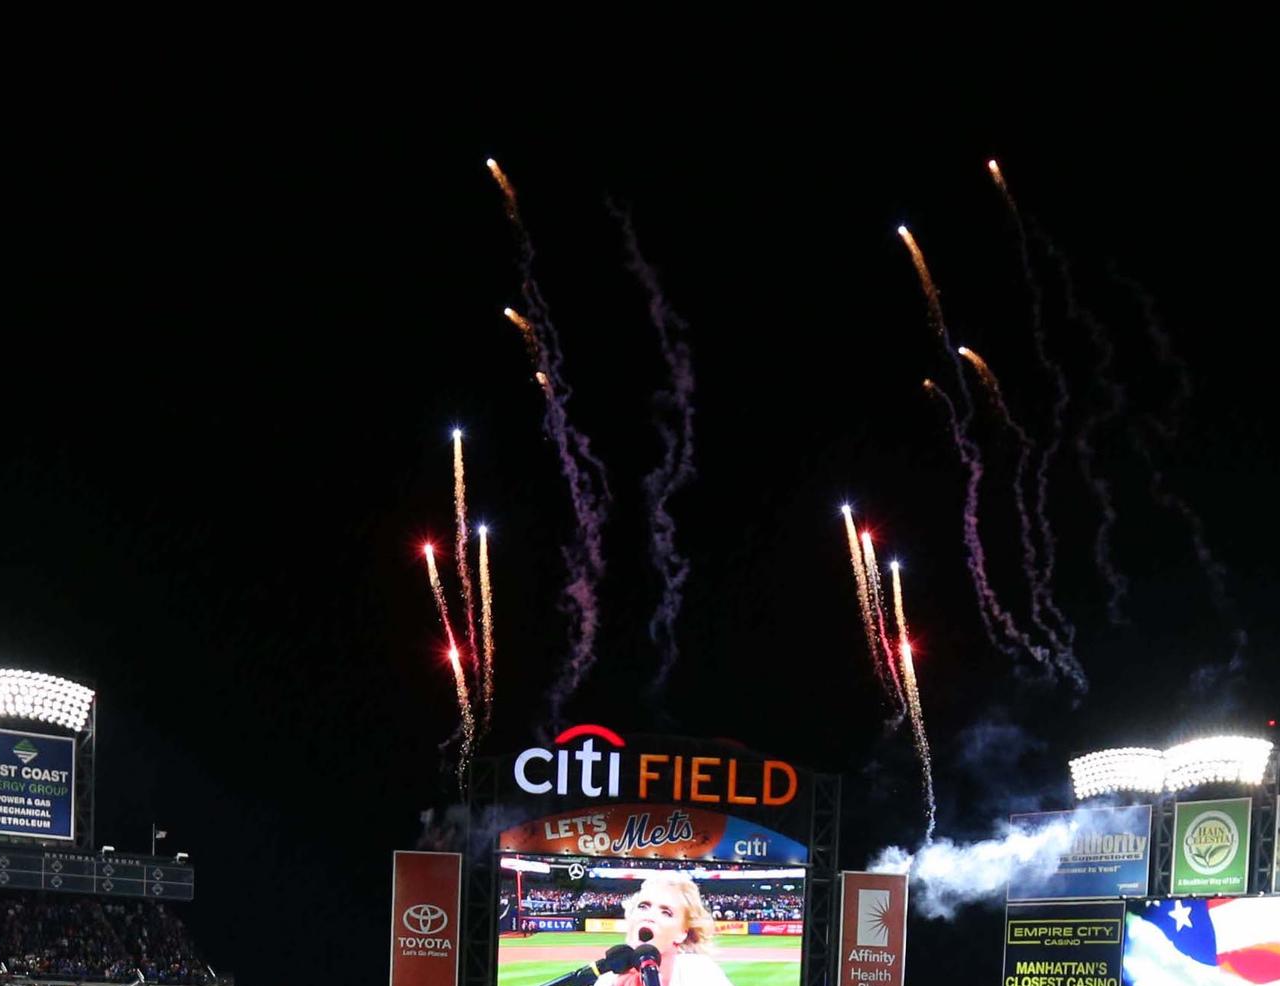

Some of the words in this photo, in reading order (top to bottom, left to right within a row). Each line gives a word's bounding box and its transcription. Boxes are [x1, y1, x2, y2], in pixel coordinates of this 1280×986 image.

[22, 766, 68, 782] COAST
[514, 738, 620, 797] citi
[639, 754, 798, 805] FIELD
[28, 783, 68, 796] GROUP
[27, 797, 34, 806] &
[34, 798, 51, 807] GAS
[544, 813, 607, 840] LET'S
[611, 811, 695, 853] Mets
[1198, 826, 1225, 836] HAIN
[578, 832, 610, 852] GO
[734, 836, 768, 857] citi
[538, 920, 573, 929] DELTA
[1014, 927, 1073, 936] EMPIRE
[1078, 926, 1113, 936] CITY
[398, 937, 452, 949] TOYOTA
[848, 950, 896, 966] Affinity
[851, 968, 891, 982] Health
[1016, 962, 1108, 975] MANHATTAN'S
